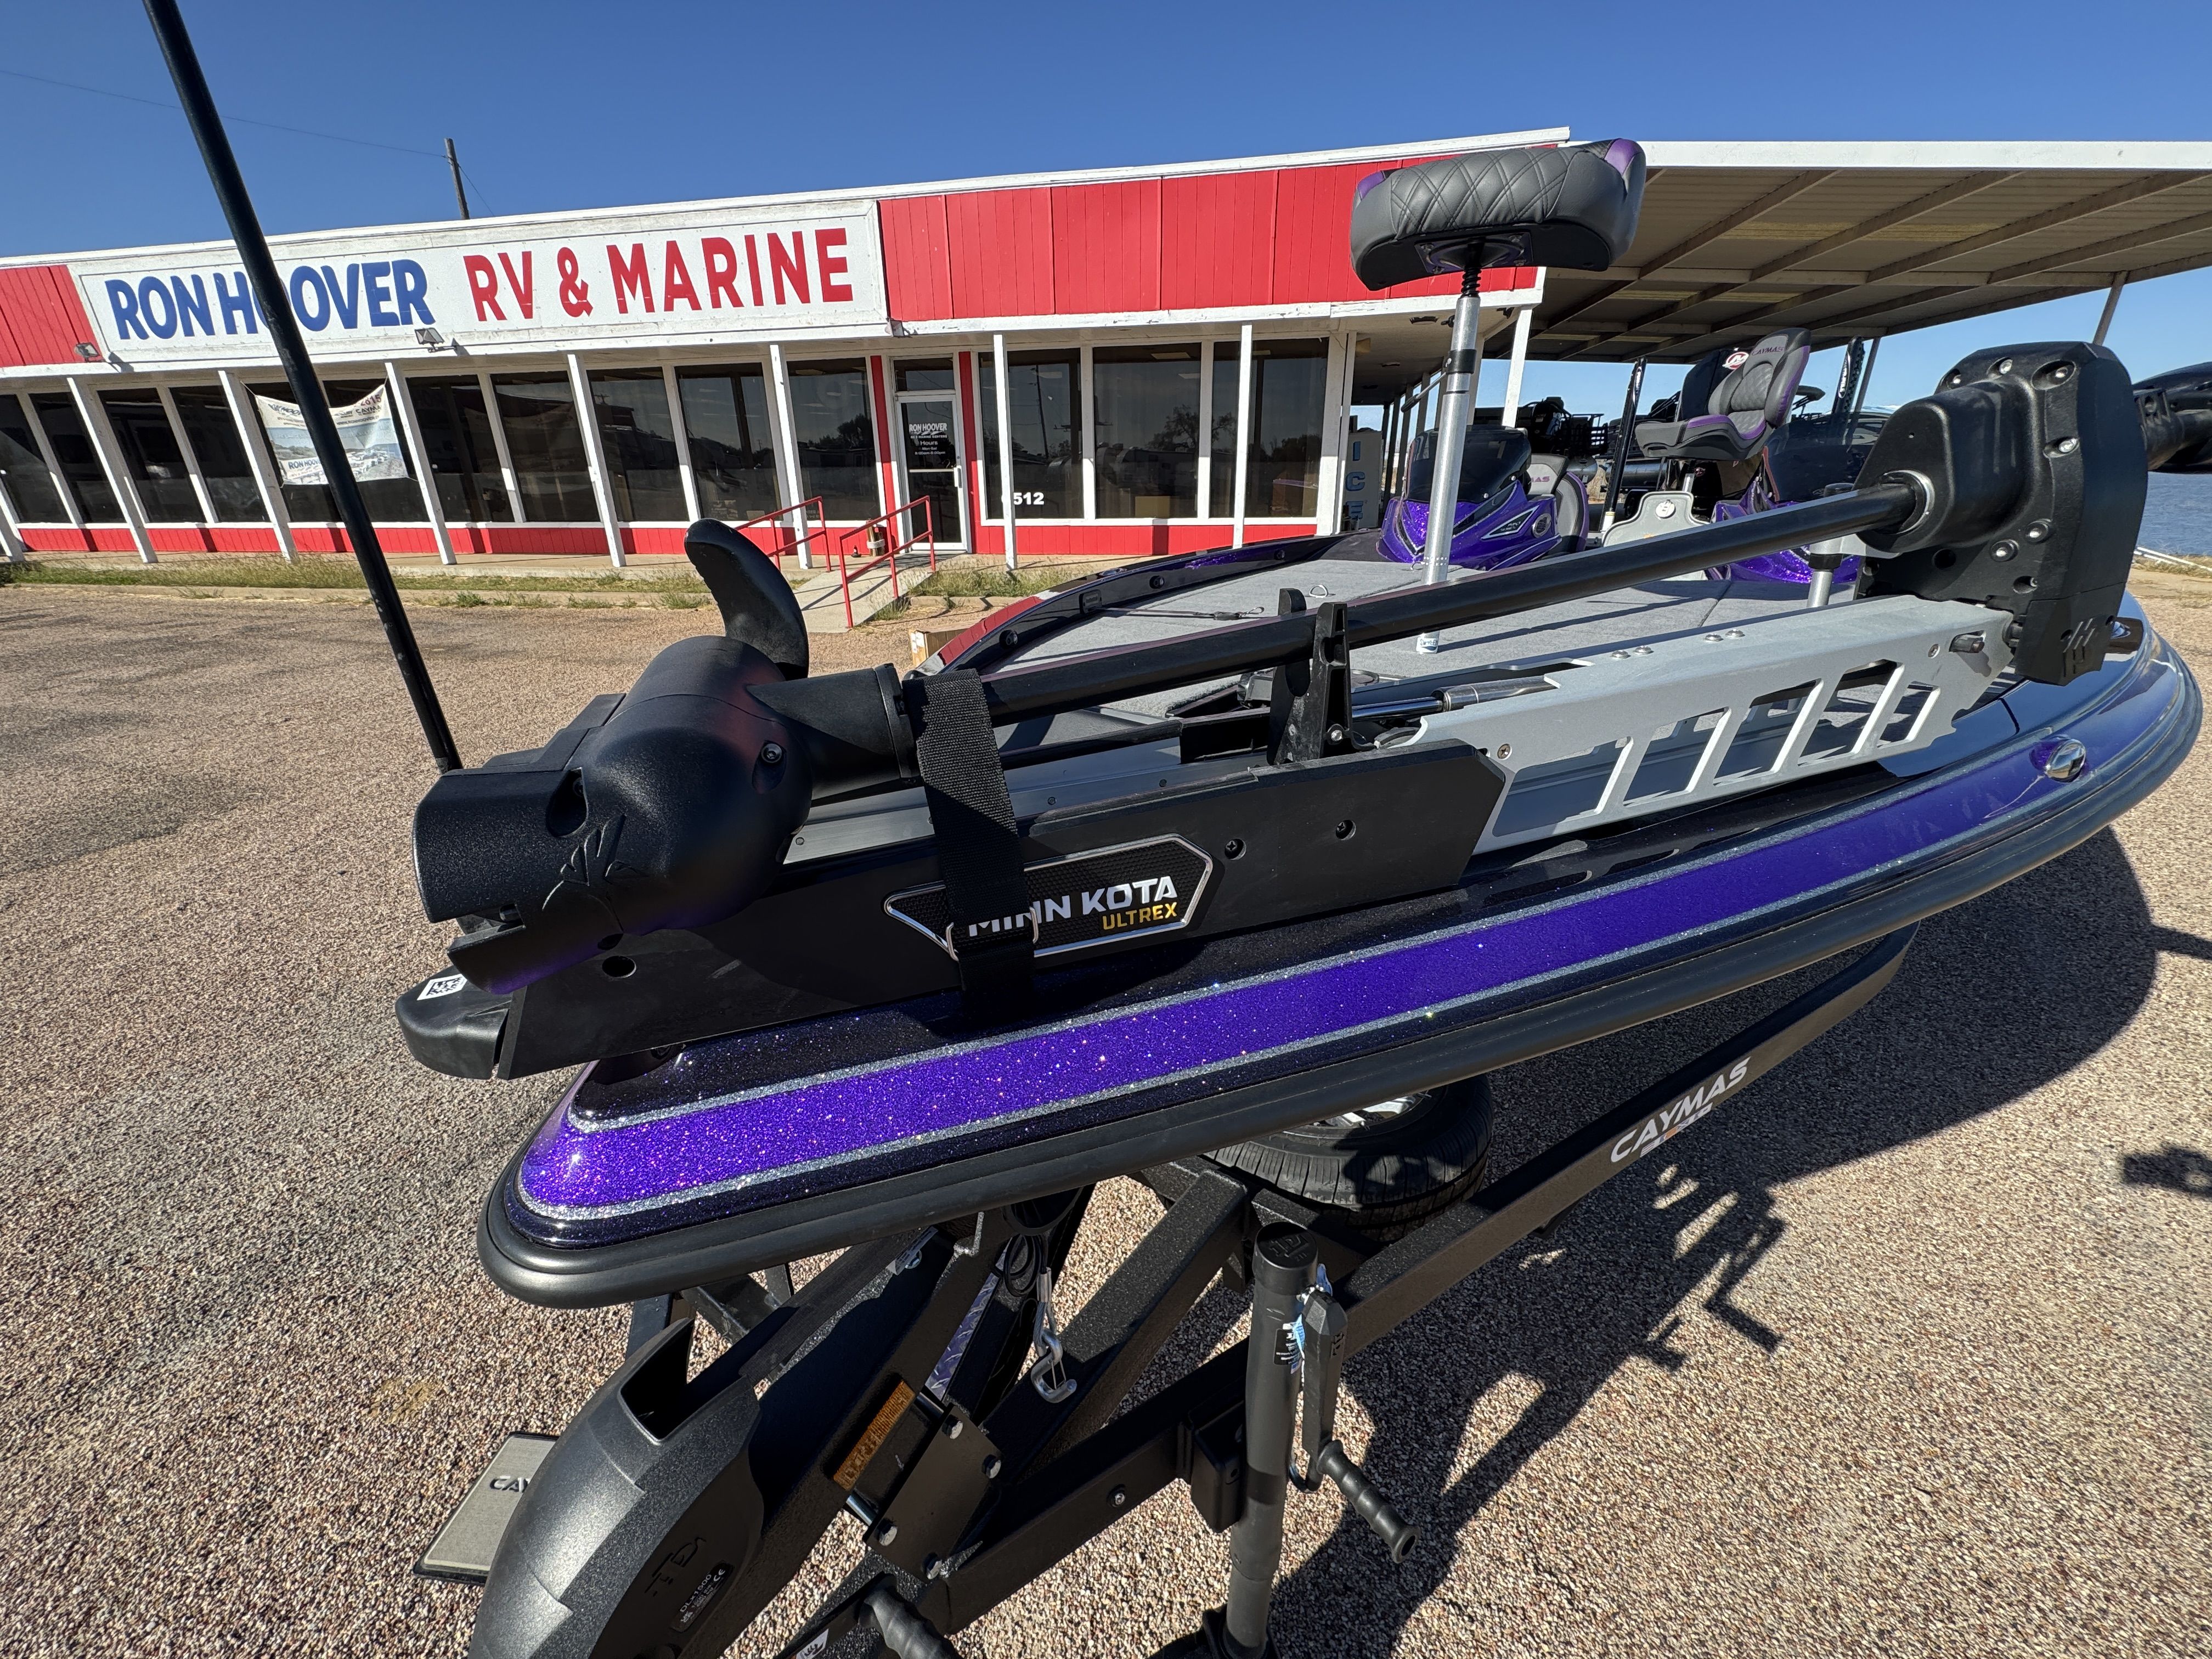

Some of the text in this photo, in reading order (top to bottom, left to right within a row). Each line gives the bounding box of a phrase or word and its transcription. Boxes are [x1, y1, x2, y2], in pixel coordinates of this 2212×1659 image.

[105, 228, 854, 340] RON HOVER RV & MARINE
[909, 423, 947, 432] RON HOOVER
[1001, 492, 1045, 505] 512
[1081, 876, 1178, 915] KOTA
[1102, 901, 1178, 931] ULTREX
[1611, 1056, 1751, 1163] CAYMAS
